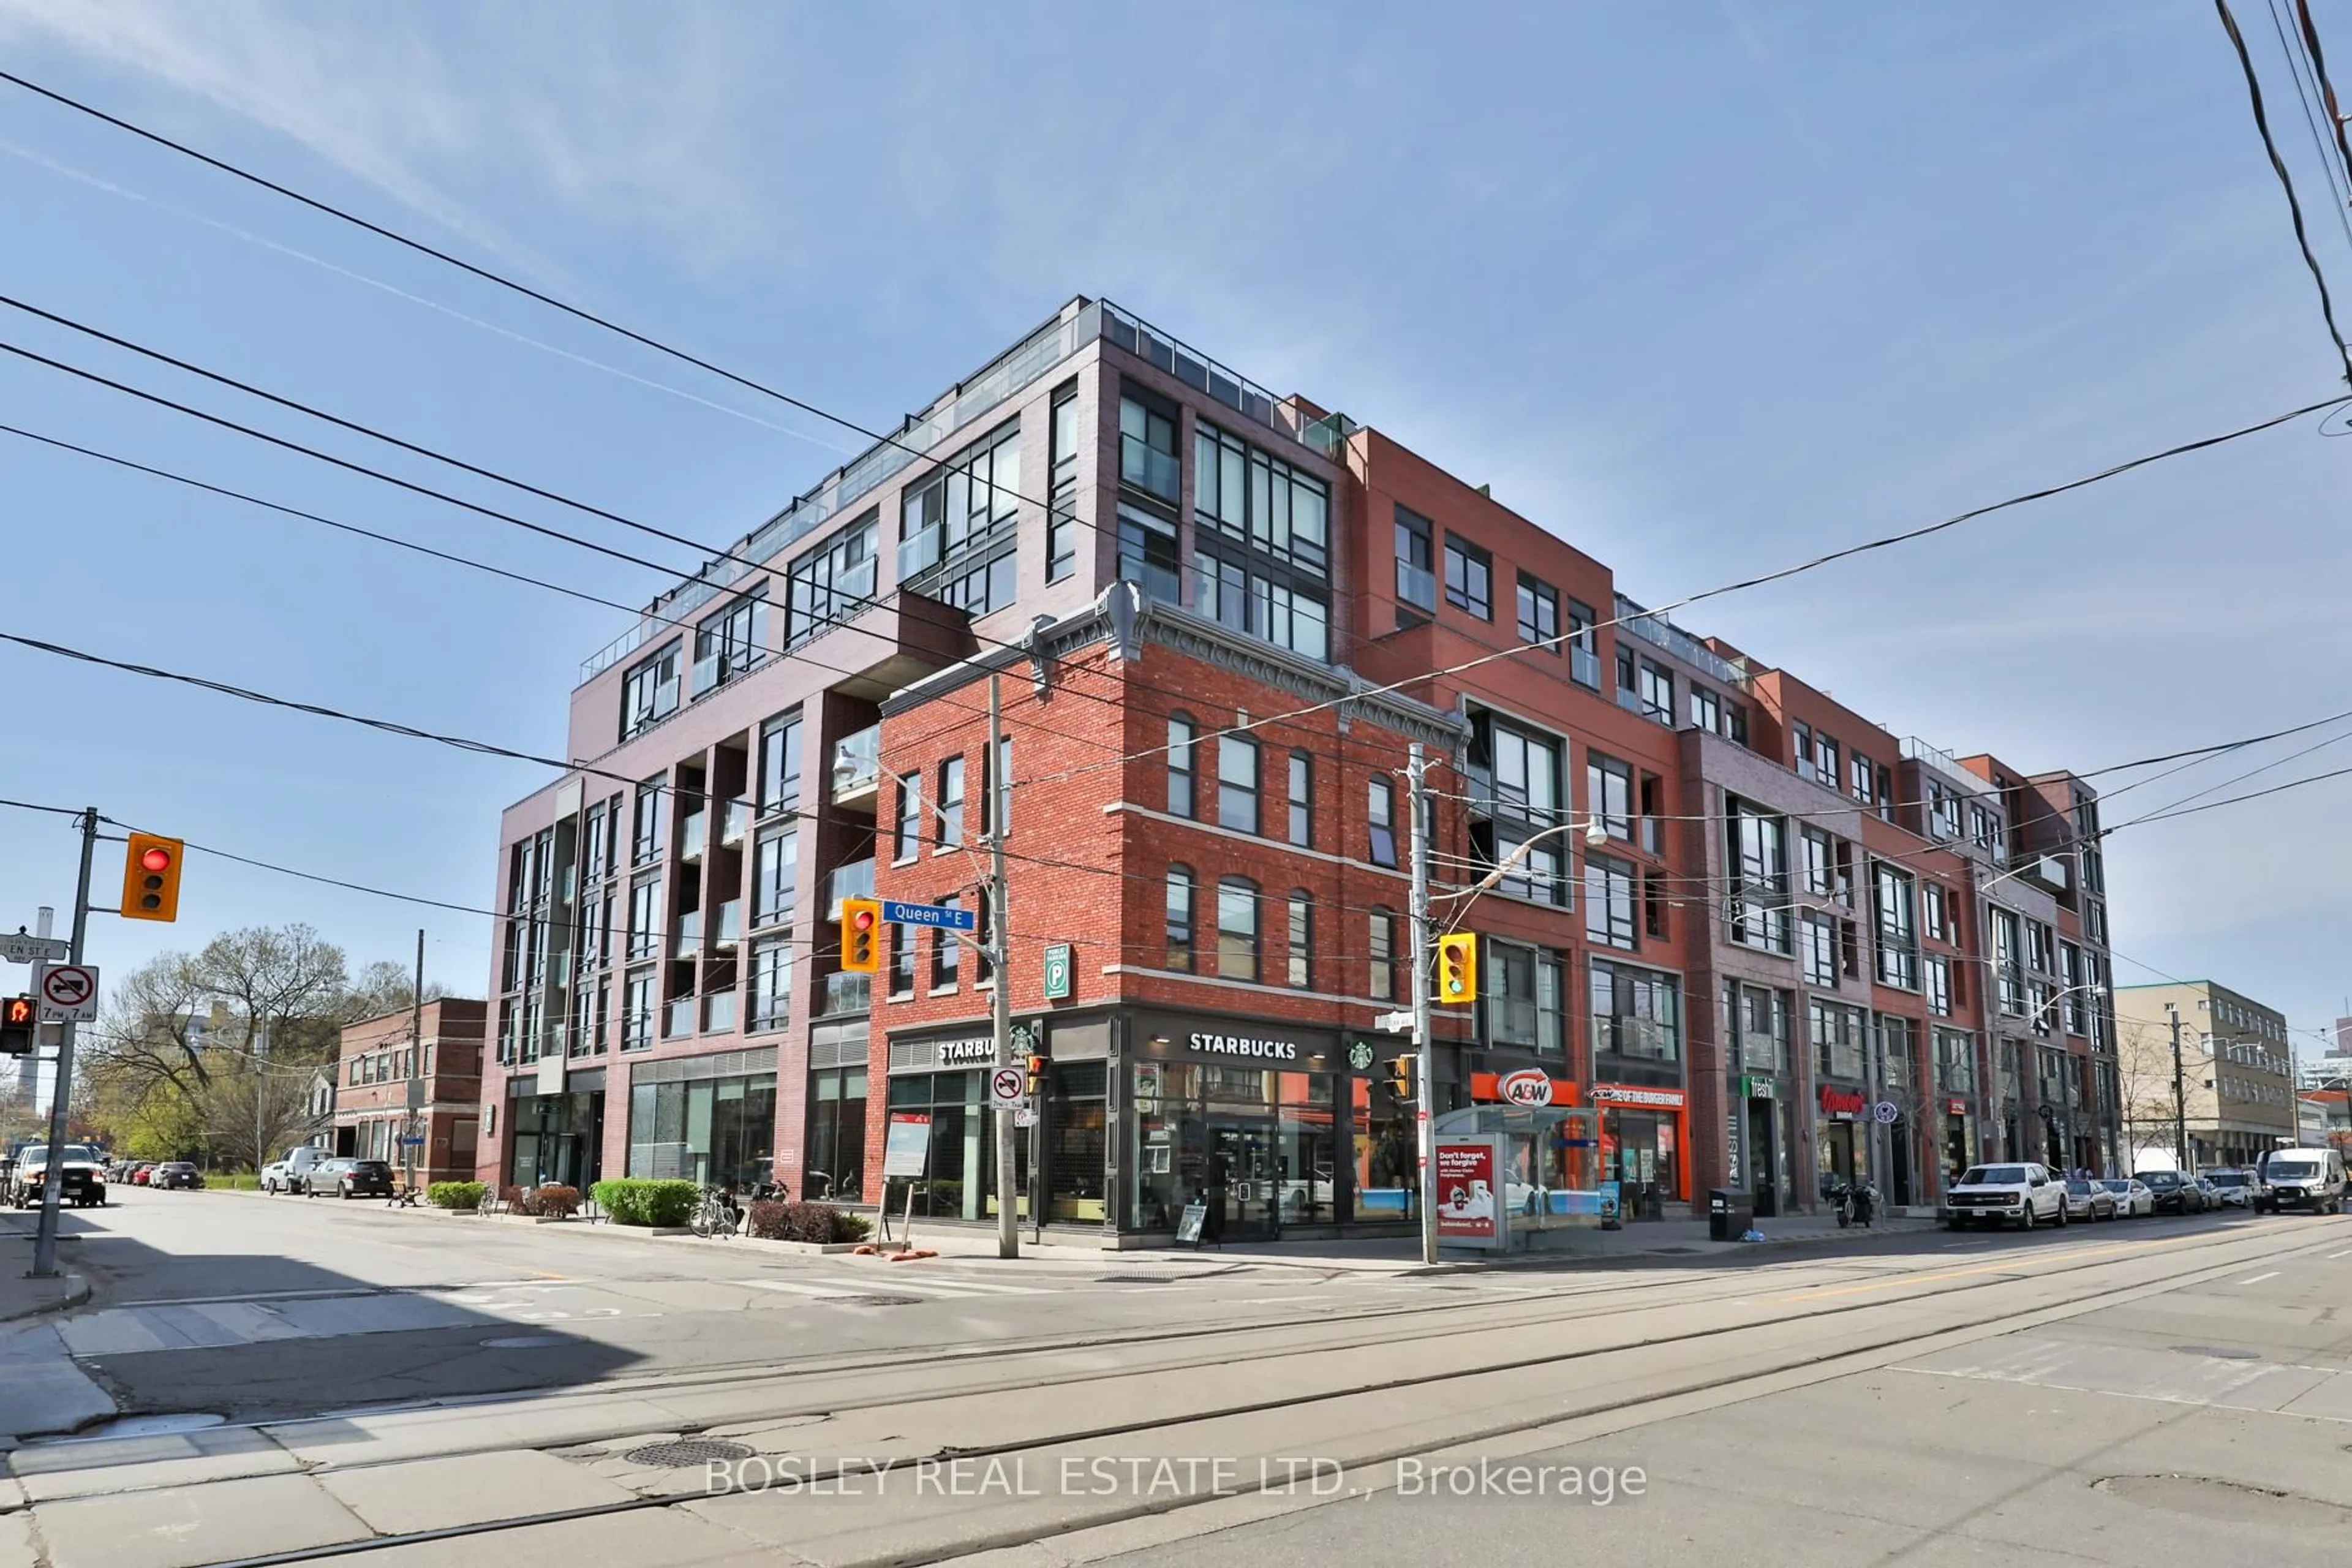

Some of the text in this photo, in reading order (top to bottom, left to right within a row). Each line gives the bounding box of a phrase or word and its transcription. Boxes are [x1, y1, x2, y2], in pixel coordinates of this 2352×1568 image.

[895, 905, 940, 922] Queen
[955, 912, 962, 925] E
[28, 946, 40, 956] ST
[1052, 965, 1062, 986] P
[43, 1008, 51, 1018] 7
[72, 1009, 80, 1018] 7
[938, 1039, 995, 1060] STARBU
[1190, 1033, 1295, 1060] STARBUCKS
[1512, 1083, 1547, 1101] A&W
